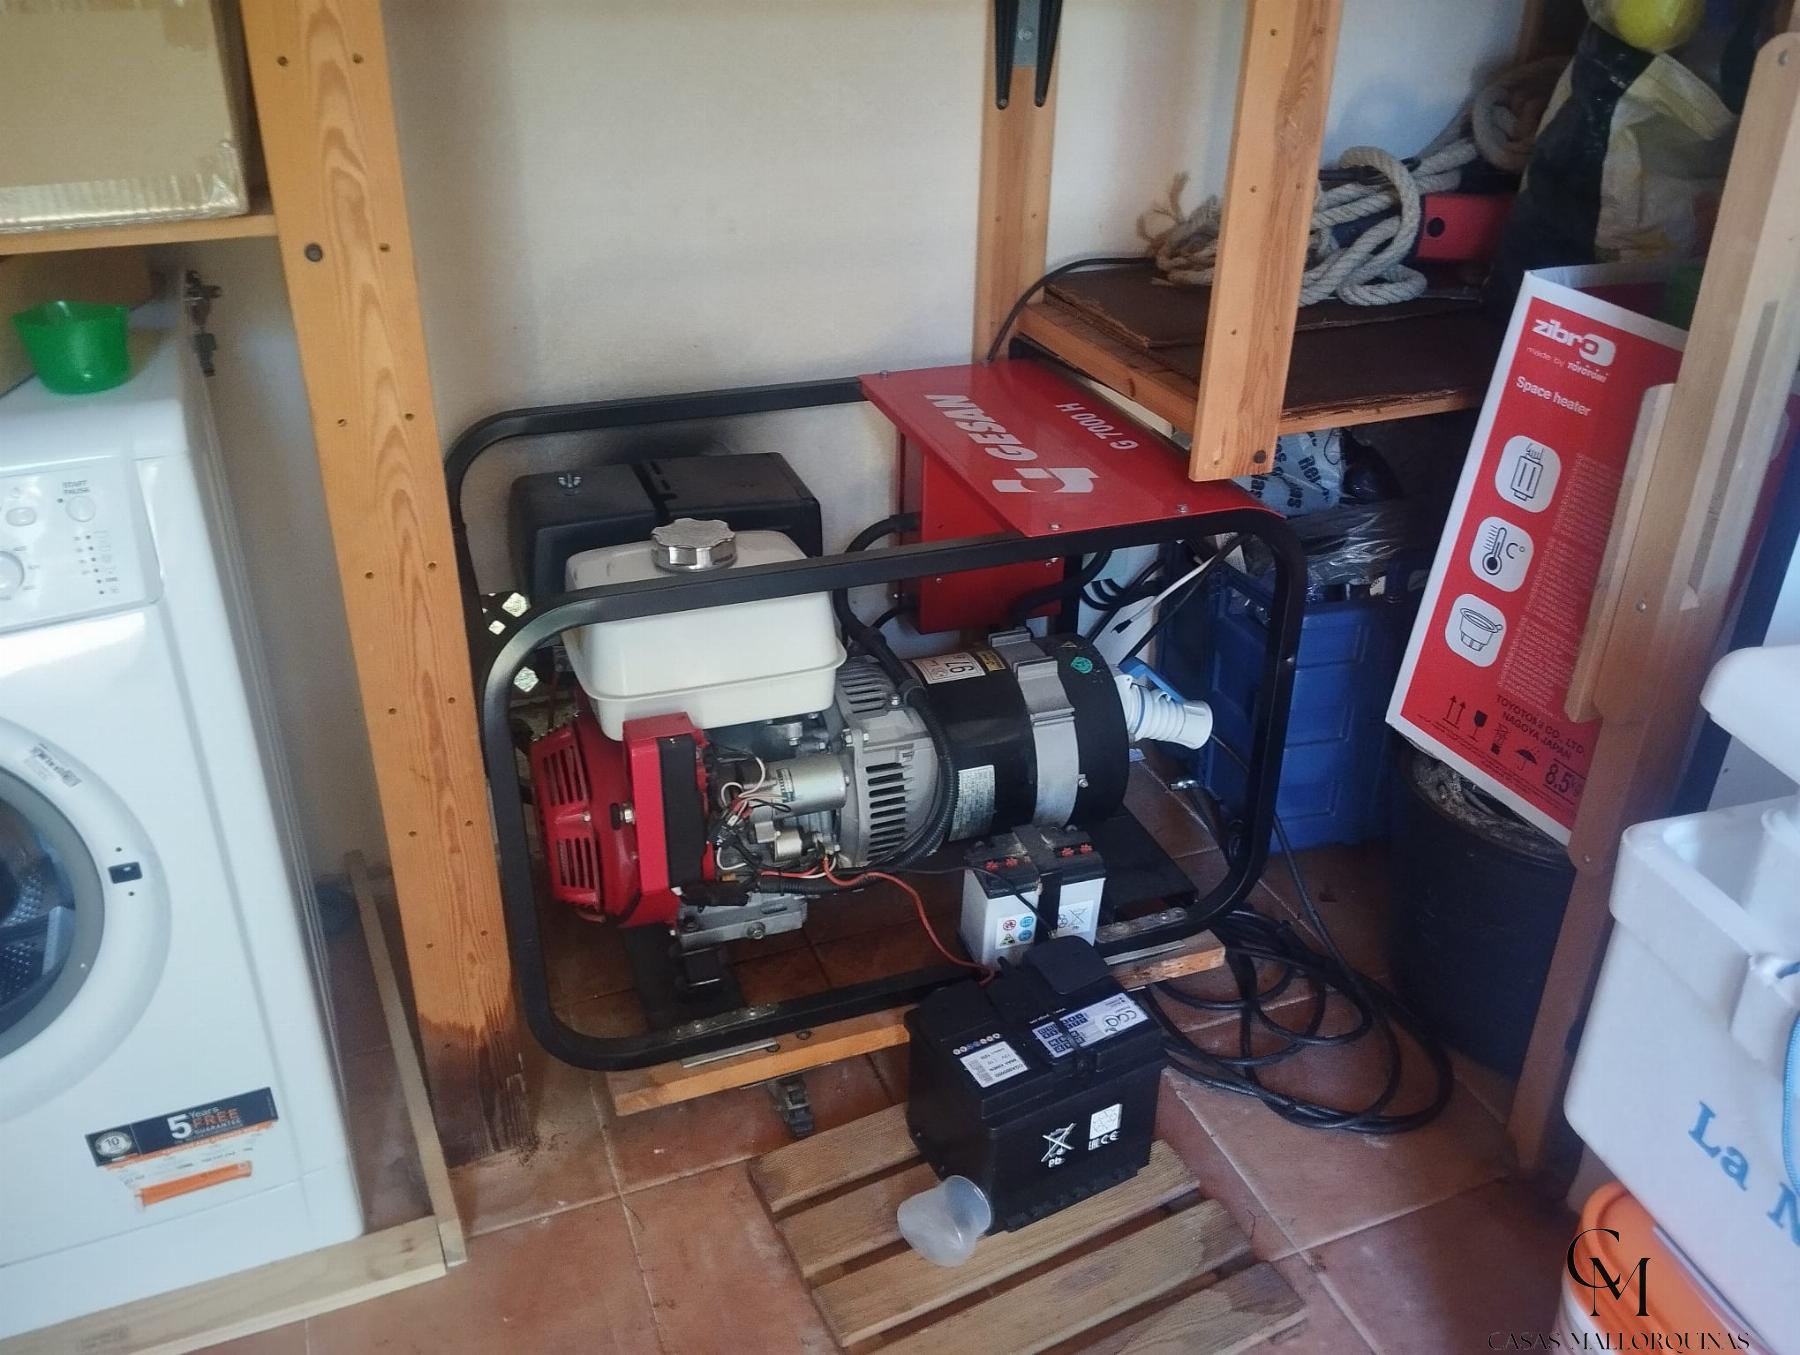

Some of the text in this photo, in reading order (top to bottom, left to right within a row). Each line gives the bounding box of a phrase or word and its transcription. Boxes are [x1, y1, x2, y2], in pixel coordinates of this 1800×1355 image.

[1531, 319, 1617, 367] zibro
[1516, 376, 1592, 416] Space heater
[923, 394, 1038, 461] GESAN
[1055, 402, 1138, 450] G 7000 H
[167, 1113, 192, 1139] 5
[192, 1108, 239, 1129] FREE
[1688, 1101, 1748, 1192] La
